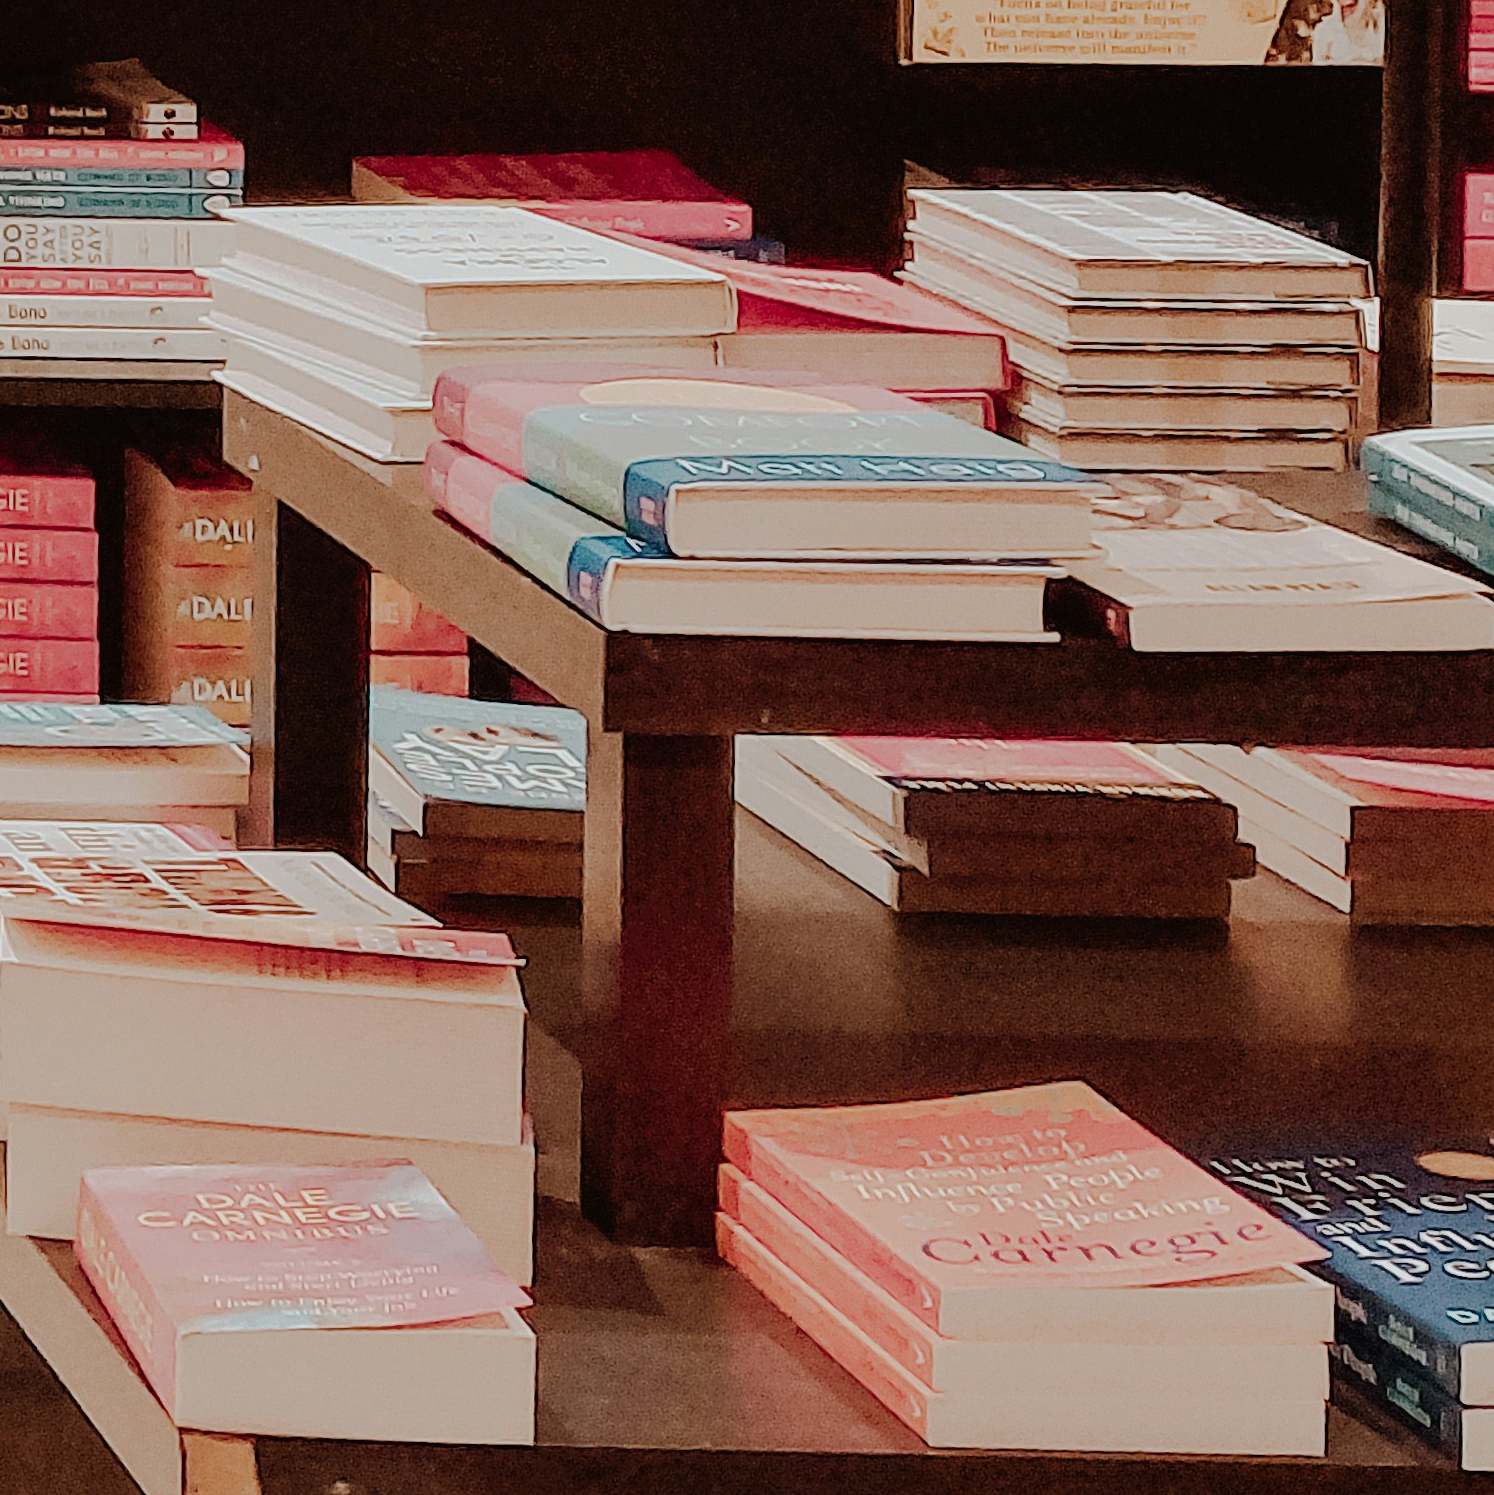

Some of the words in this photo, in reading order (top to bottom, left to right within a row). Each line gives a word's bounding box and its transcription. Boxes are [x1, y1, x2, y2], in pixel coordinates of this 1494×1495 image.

[3, 223, 23, 263] DO
[26, 223, 39, 263] YOU
[42, 225, 57, 263] SAY
[71, 223, 85, 263] YOU
[87, 226, 103, 263] SAY
[919, 1141, 1086, 1168] Develop
[939, 1133, 1019, 1150] How
[1033, 1126, 1068, 1148] to
[195, 1187, 334, 1210] DALE
[855, 1179, 1024, 1204] Influence
[1042, 1166, 1164, 1193] People
[1229, 1171, 1408, 1195] Win
[136, 1199, 421, 1229] CARNEGIE
[989, 1192, 1115, 1214] Public
[1034, 1195, 1233, 1231] Speaking
[190, 1225, 390, 1244] OMNIBUS
[922, 1221, 1275, 1266] Carnegie
[1315, 1217, 1393, 1237] and
